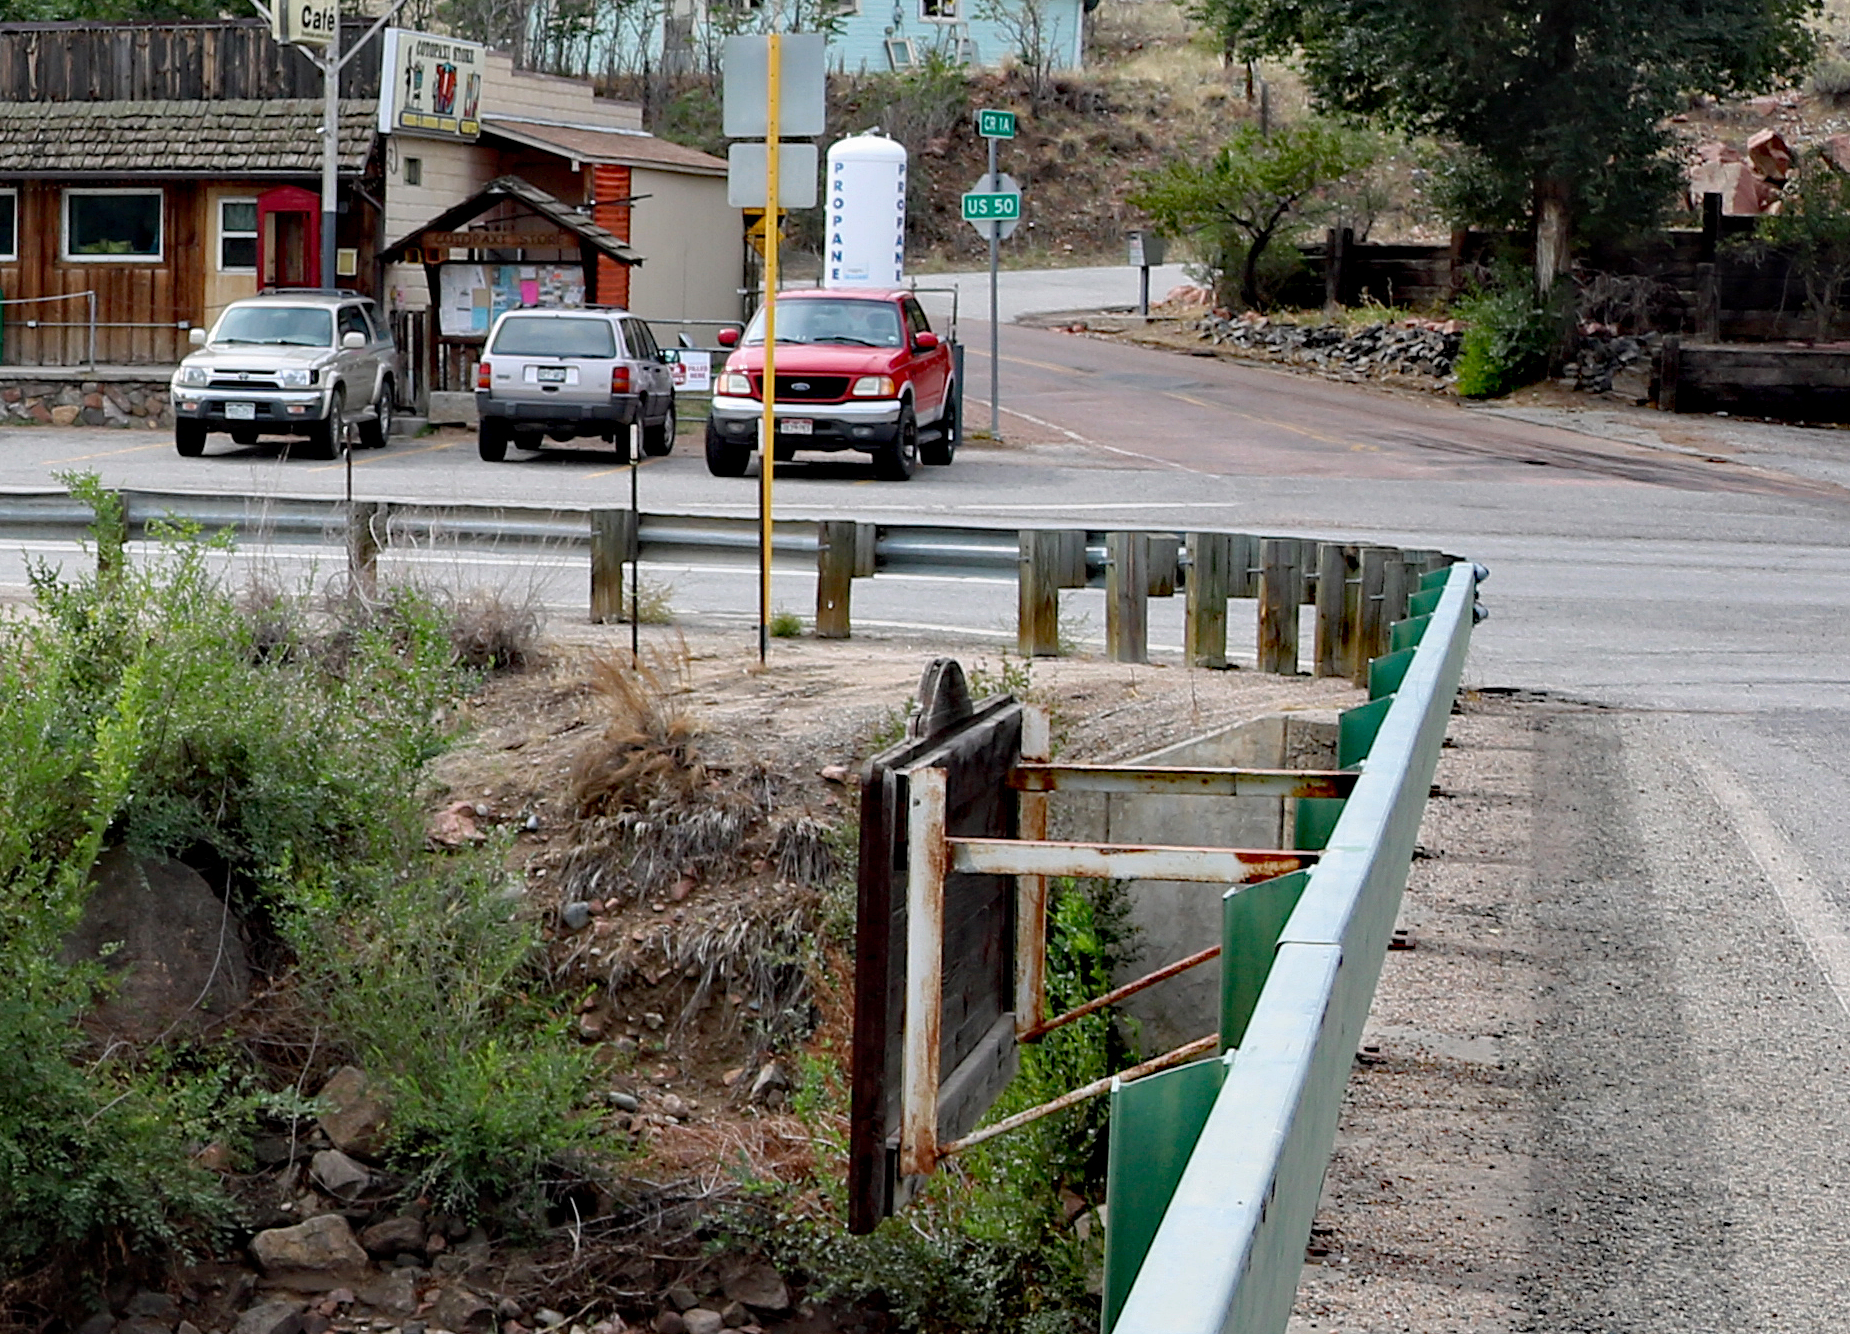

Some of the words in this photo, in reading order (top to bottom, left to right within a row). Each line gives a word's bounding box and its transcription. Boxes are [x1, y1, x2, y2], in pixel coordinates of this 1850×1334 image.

[302, 5, 336, 32] Café
[416, 40, 451, 59] COTOPAXI
[984, 115, 996, 131] CR
[999, 117, 1010, 132] 1A
[967, 199, 988, 215] US
[993, 198, 1014, 214] 50
[831, 162, 845, 281] PROPANE
[895, 163, 906, 282] PROPANE
